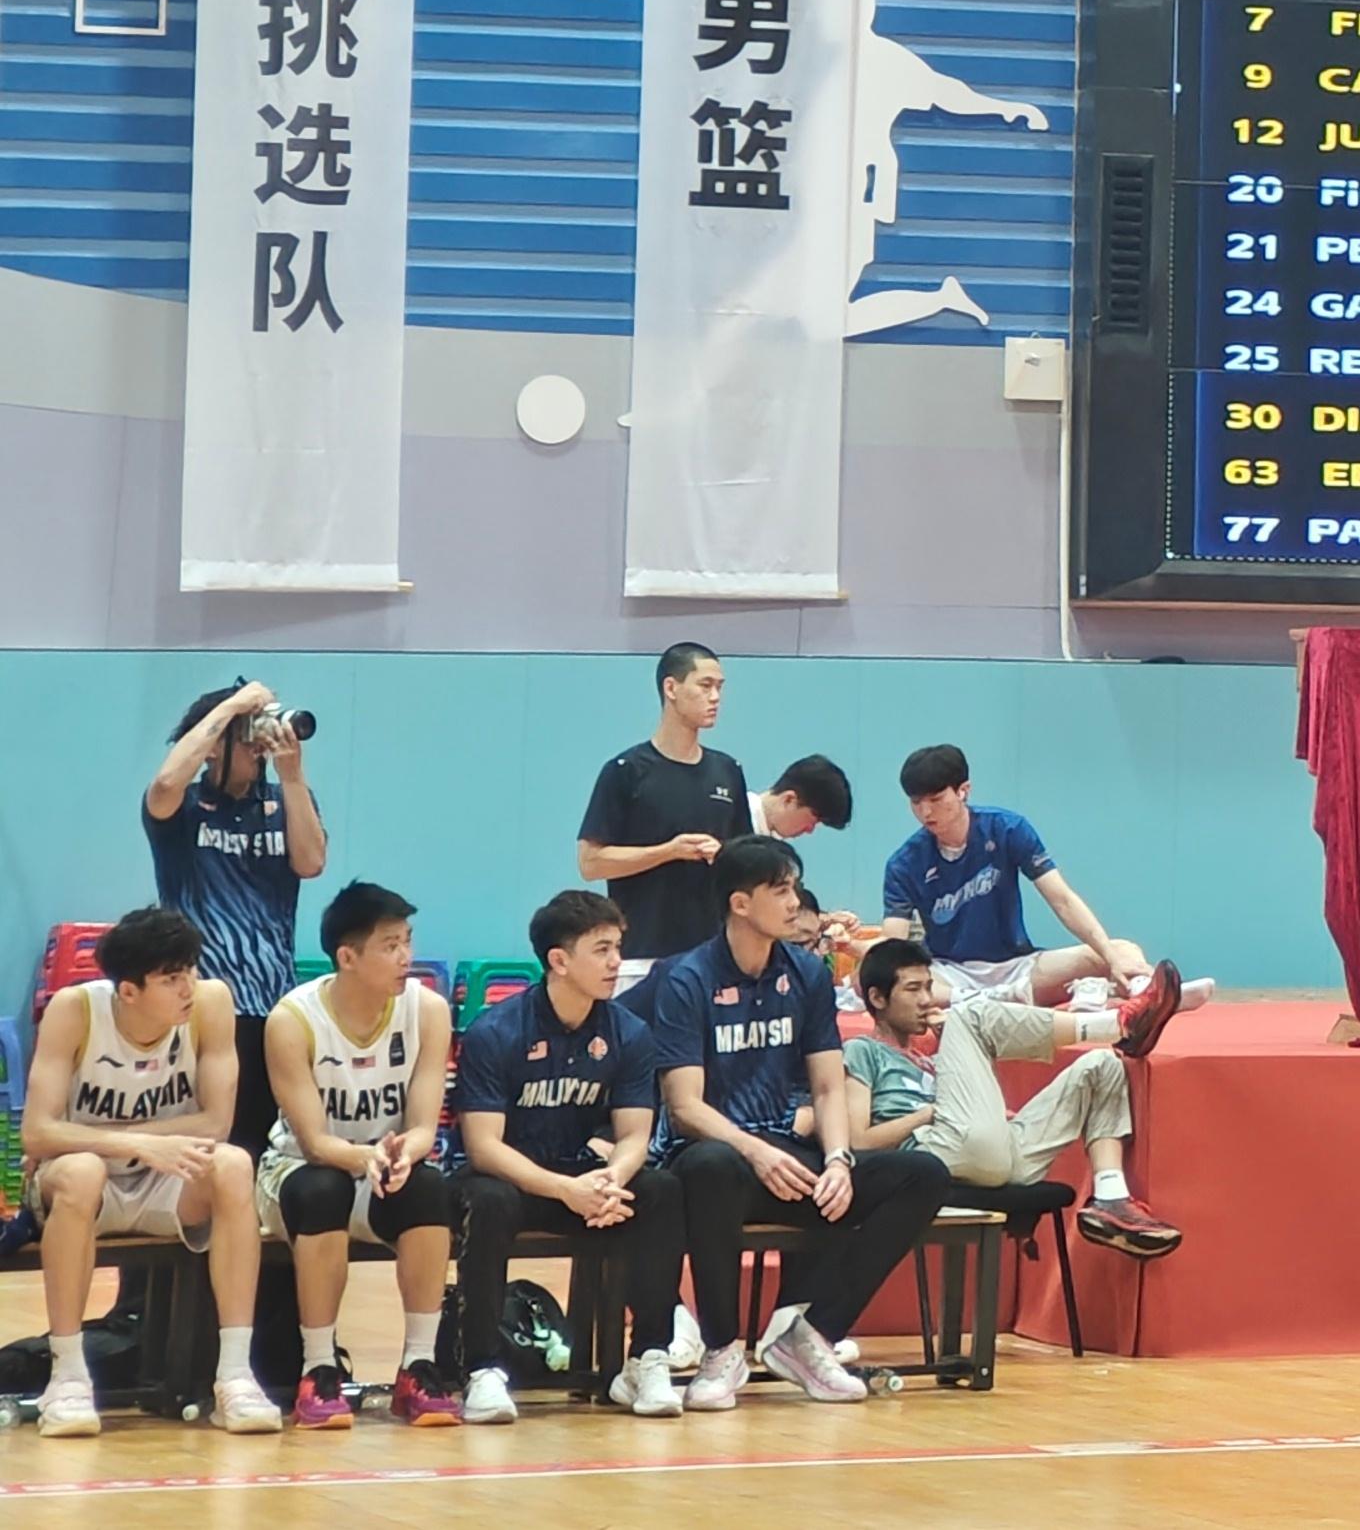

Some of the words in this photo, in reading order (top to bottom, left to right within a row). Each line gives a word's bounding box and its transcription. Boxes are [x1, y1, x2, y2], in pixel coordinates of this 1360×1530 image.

[1246, 8, 1273, 30] 7
[1245, 65, 1271, 88] 9
[1234, 119, 1283, 144] 12
[1228, 175, 1283, 203] 20
[1227, 233, 1277, 259] 21
[1225, 290, 1281, 316] 24
[1224, 345, 1279, 372] 25
[1226, 404, 1281, 429] 30
[1225, 460, 1278, 484] 63
[1223, 517, 1280, 542] 77
[76, 1071, 193, 1120] MALAYIA
[516, 1077, 601, 1107] MALYIA
